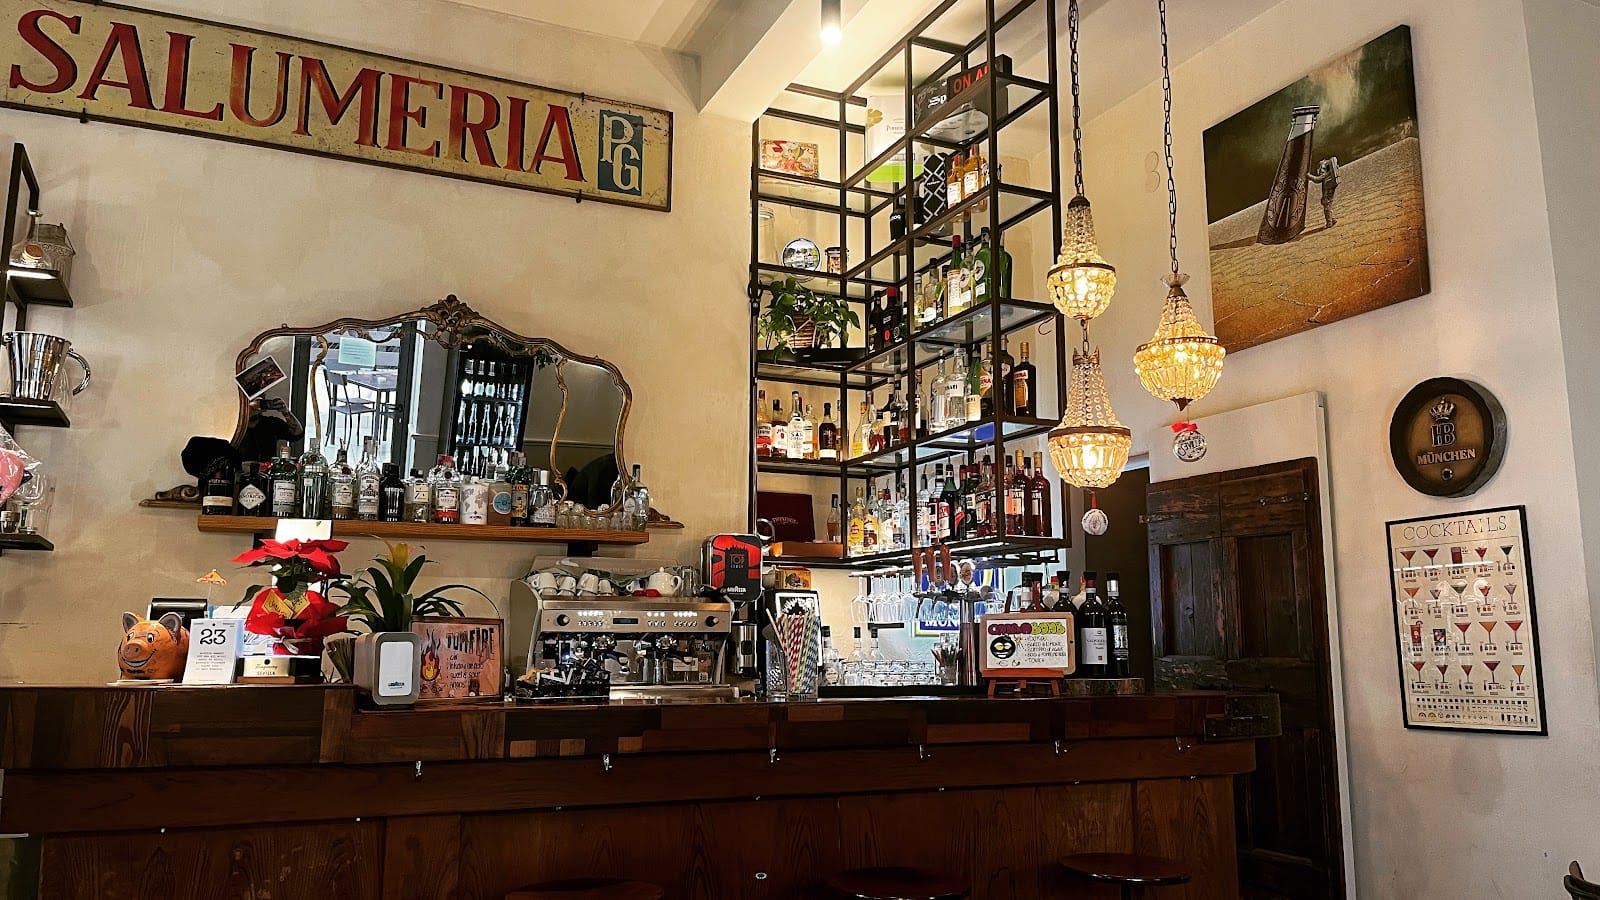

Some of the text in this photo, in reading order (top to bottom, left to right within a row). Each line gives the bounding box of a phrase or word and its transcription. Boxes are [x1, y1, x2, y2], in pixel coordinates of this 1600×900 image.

[953, 73, 972, 93] ON
[9, 8, 588, 183] SALUMERIA
[1431, 422, 1456, 447] HB
[1417, 448, 1476, 465] MÜNCHEN
[1403, 515, 1507, 541] COCKTAILS
[199, 628, 227, 645] 23
